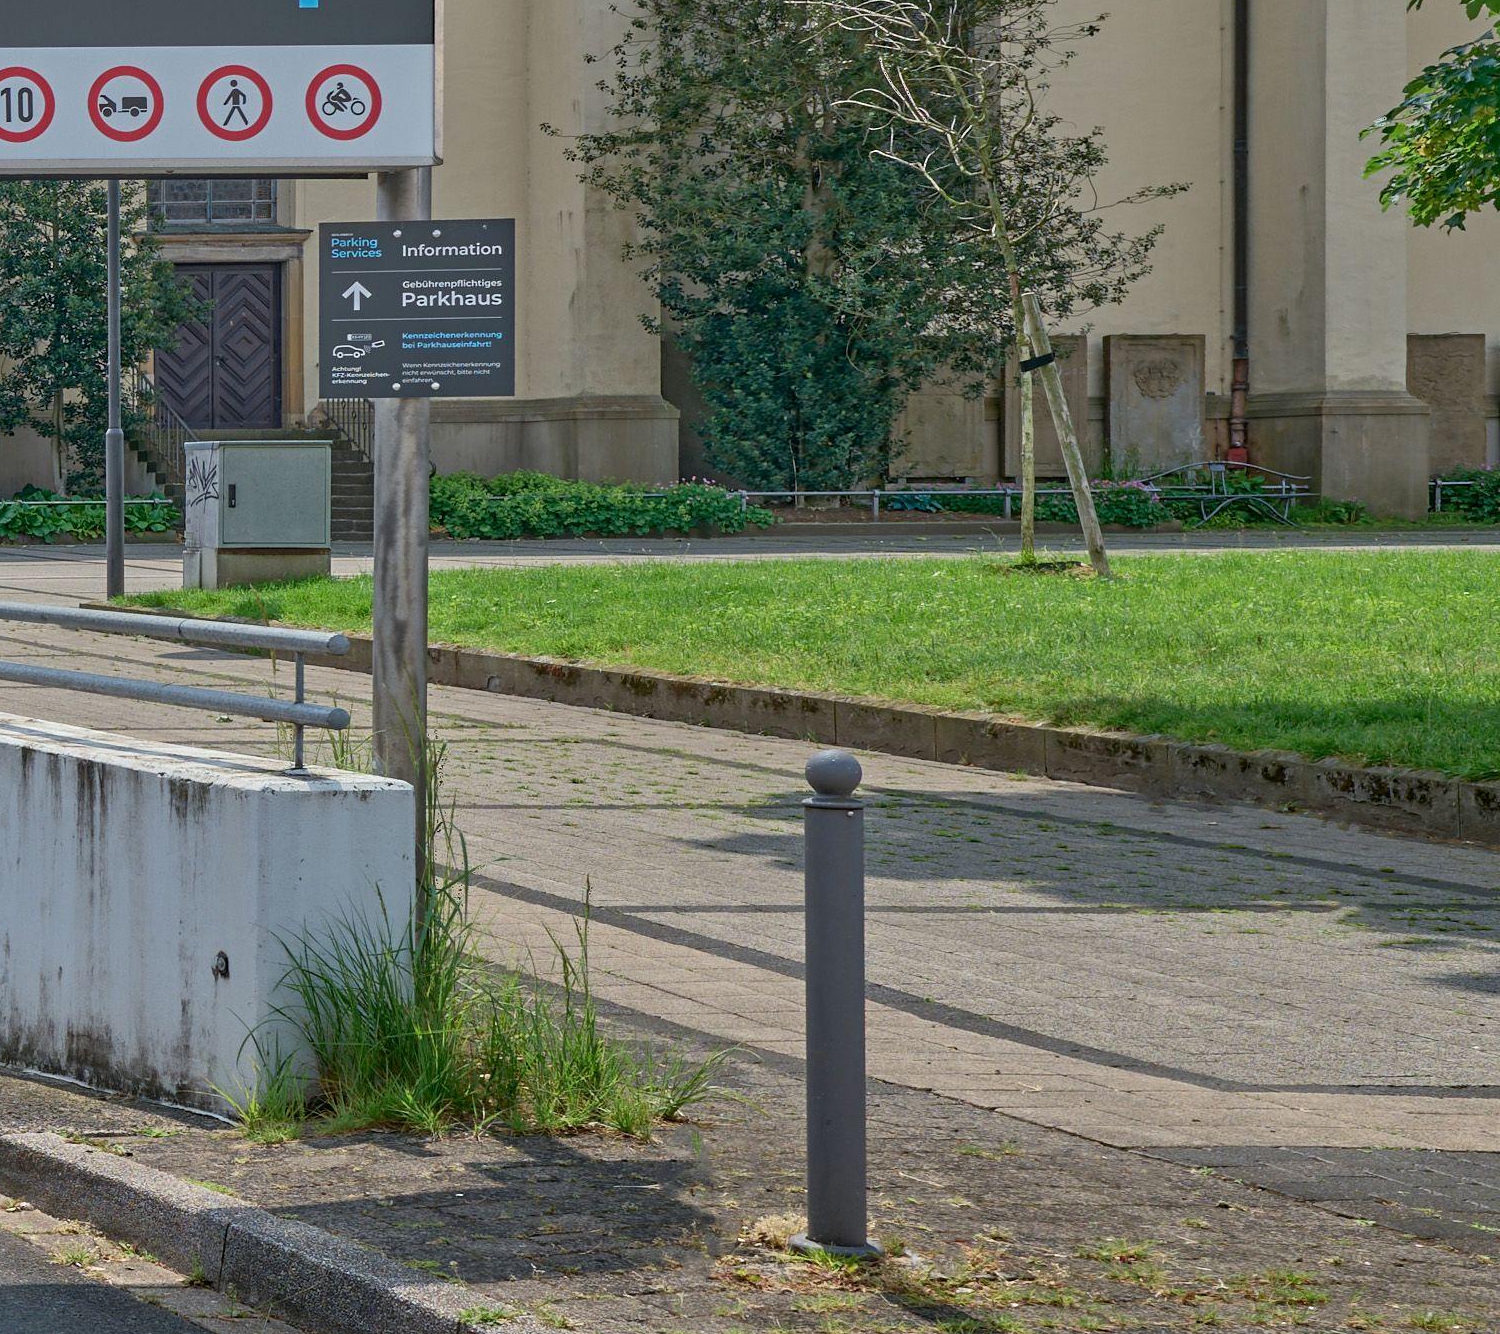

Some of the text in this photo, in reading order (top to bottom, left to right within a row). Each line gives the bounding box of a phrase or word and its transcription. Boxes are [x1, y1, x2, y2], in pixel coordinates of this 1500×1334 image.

[0, 87, 34, 123] 10
[331, 237, 378, 248] Parking
[331, 248, 382, 259] Services
[402, 242, 502, 257] Information
[402, 279, 502, 289] Gebührenpflichtiges
[402, 290, 502, 307] Parkhaus
[402, 331, 502, 340] Kennzeichenerkennung
[417, 341, 492, 349] Parkhauseinfahrt!
